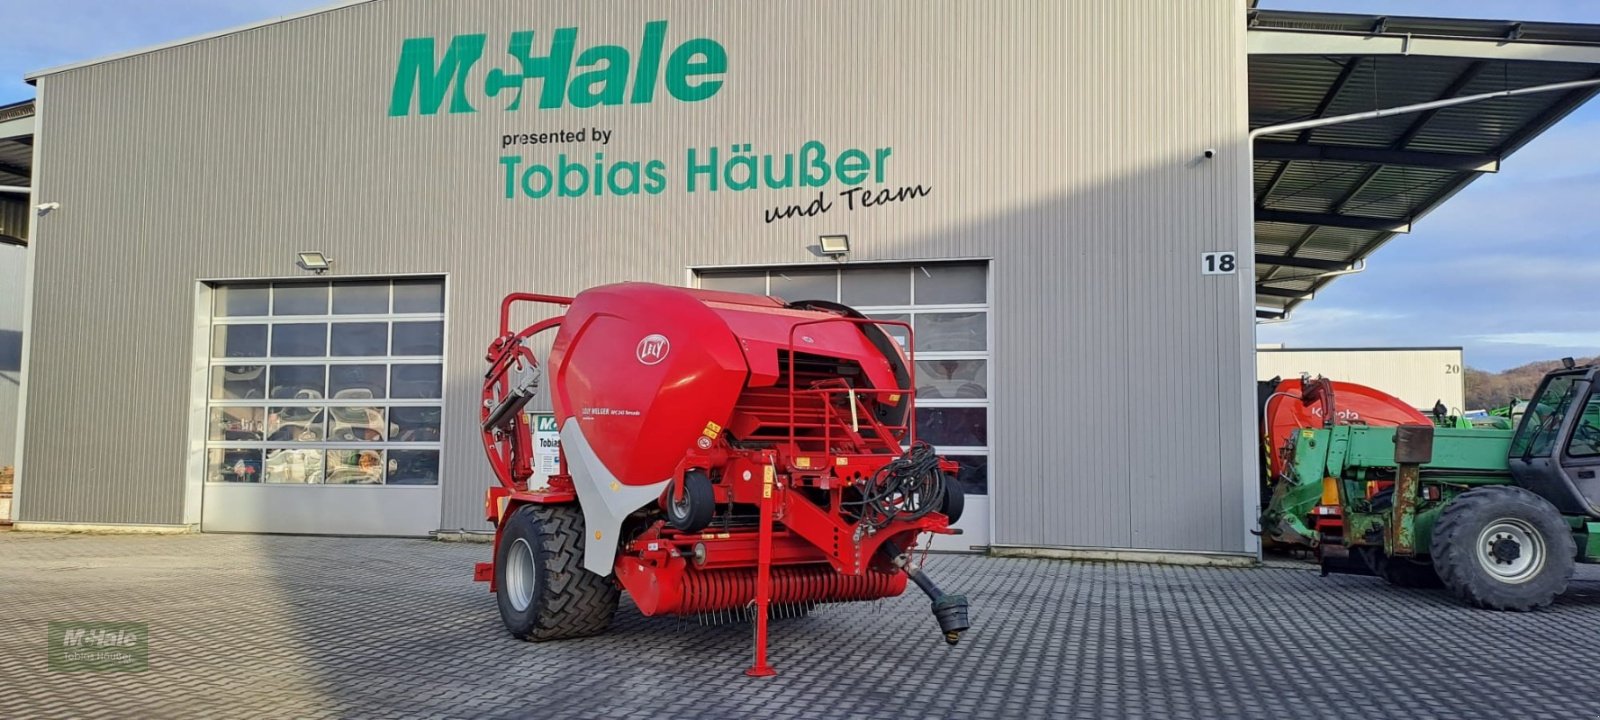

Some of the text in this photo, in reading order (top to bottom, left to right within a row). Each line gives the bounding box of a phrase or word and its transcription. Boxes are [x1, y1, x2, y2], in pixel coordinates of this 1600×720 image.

[388, 20, 728, 117] McHale
[502, 127, 612, 148] presented by
[499, 140, 892, 199] Tobias Häußer
[765, 184, 932, 223] und Team
[1205, 254, 1235, 272] 18
[640, 336, 667, 359] LELY
[1445, 363, 1460, 375] 20
